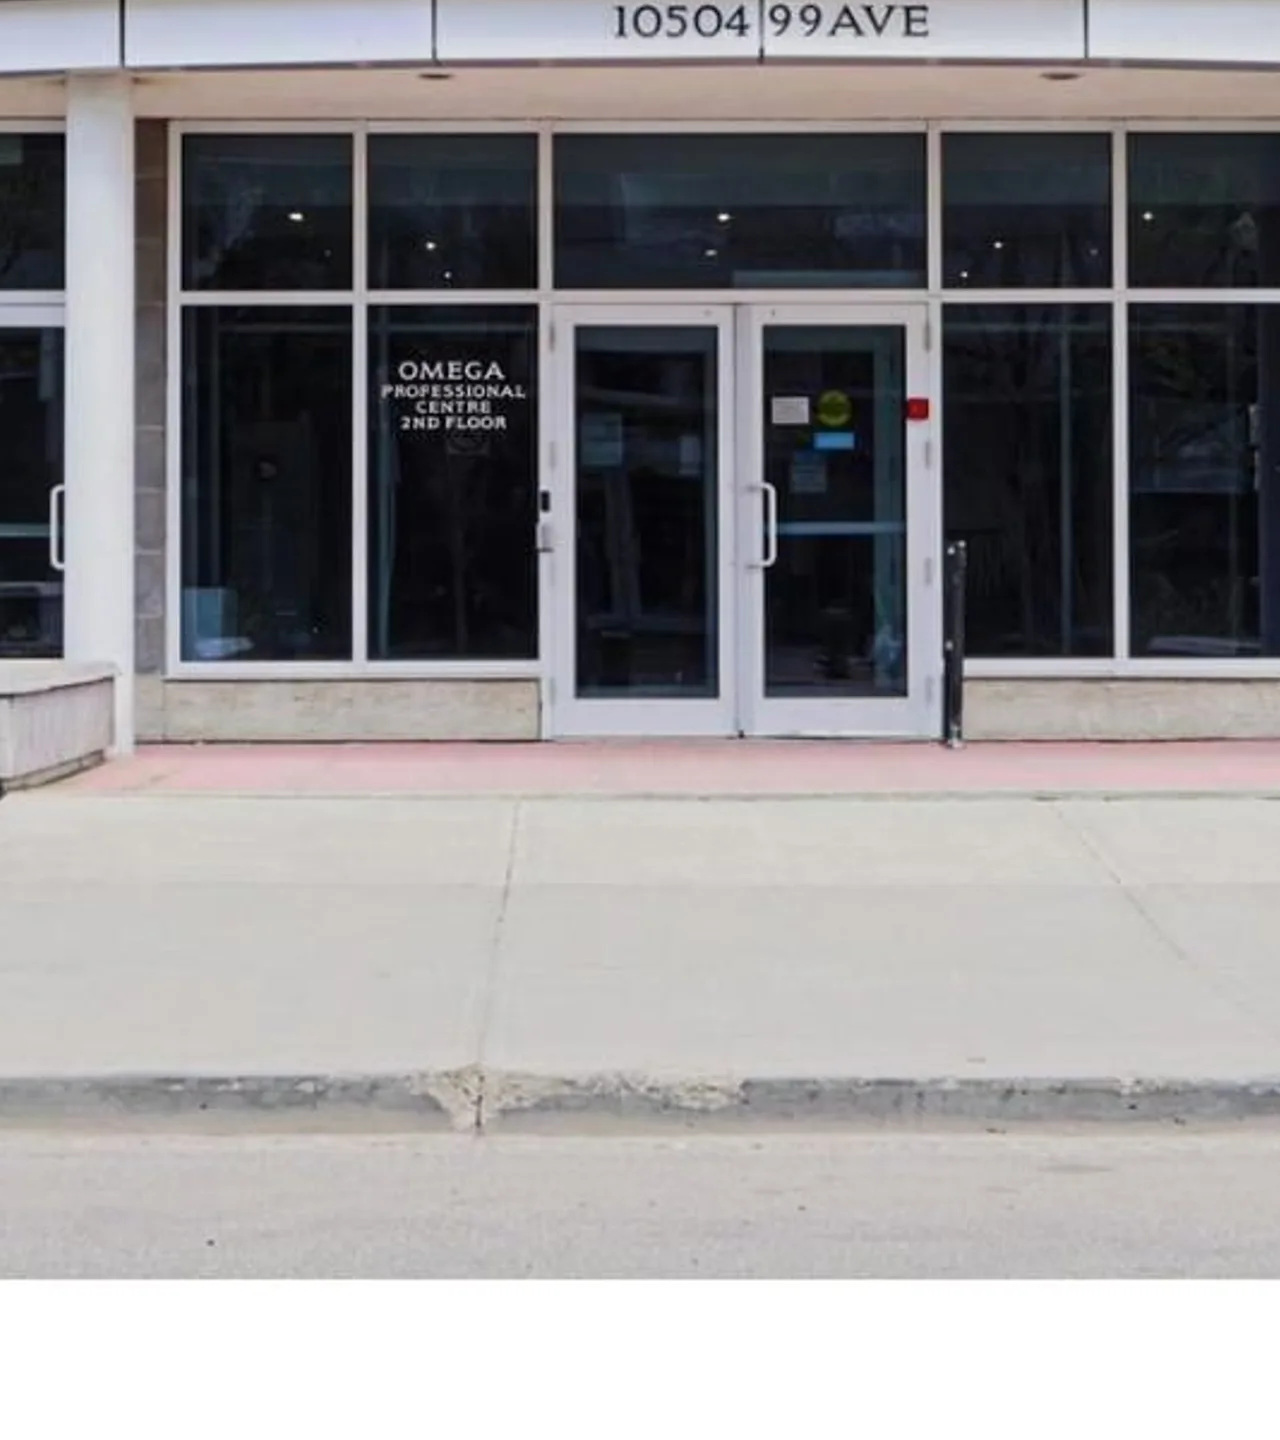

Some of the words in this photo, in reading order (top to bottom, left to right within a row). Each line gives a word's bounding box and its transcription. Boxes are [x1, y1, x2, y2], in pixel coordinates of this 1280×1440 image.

[613, 3, 751, 39] 10504
[397, 360, 506, 381] OMEGA
[380, 383, 527, 399] PROFESSIONAL
[414, 400, 492, 414] CENTRE
[400, 416, 441, 430] 2ND
[445, 415, 508, 430] FLOOR
